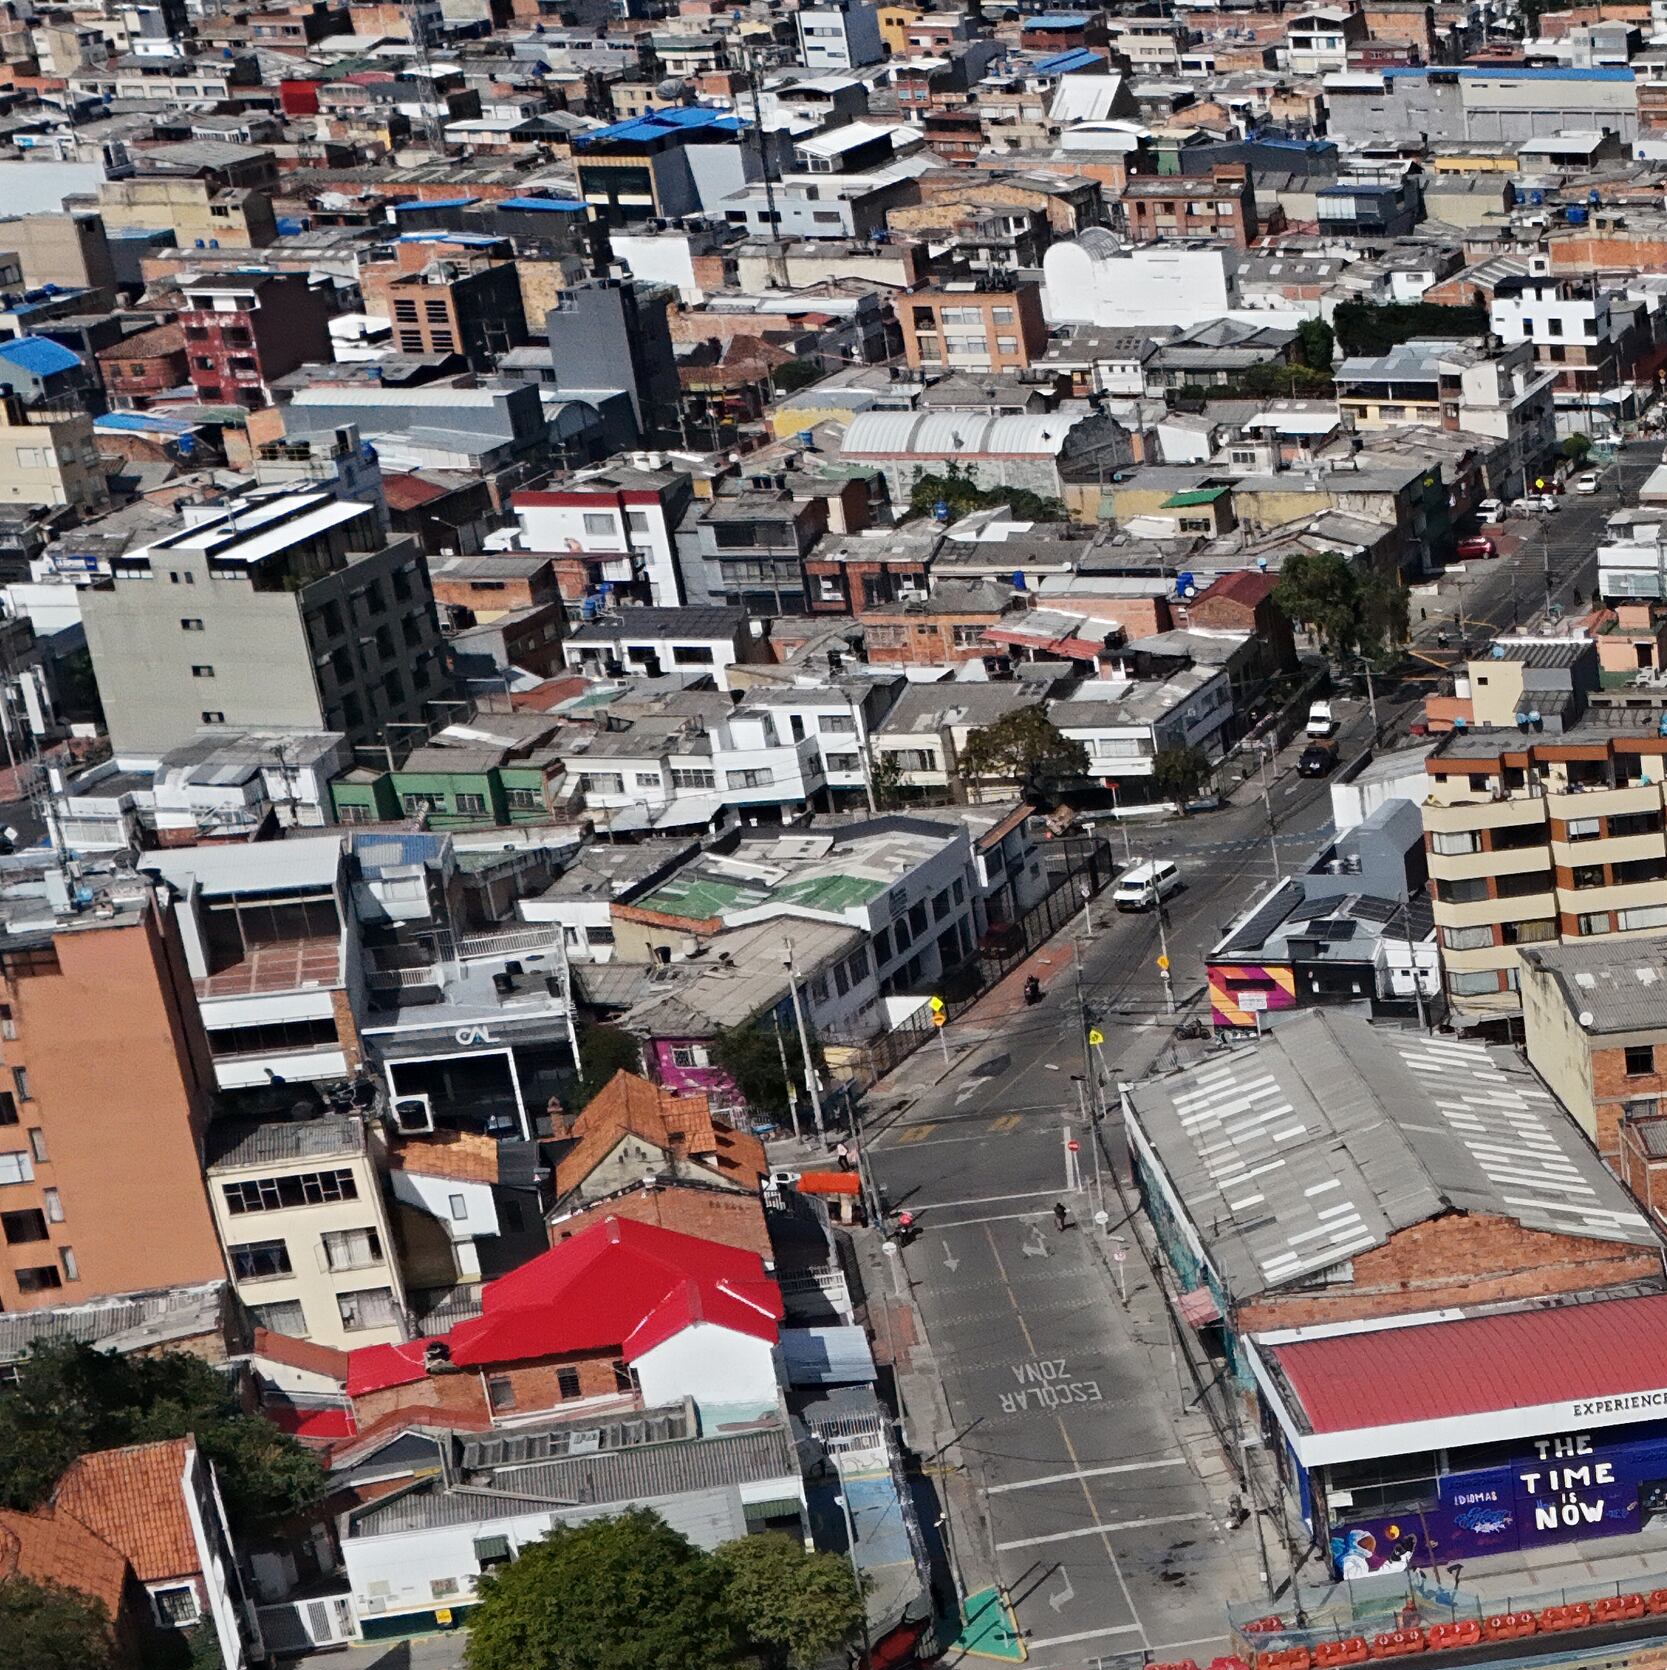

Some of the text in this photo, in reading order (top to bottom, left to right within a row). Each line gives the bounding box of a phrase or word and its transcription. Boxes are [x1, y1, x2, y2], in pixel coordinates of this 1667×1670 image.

[1012, 1360, 1071, 1384] ZONA
[999, 1382, 1103, 1412] ESCOLAR
[1534, 1435, 1593, 1460] THE
[1520, 1463, 1615, 1494] TIME
[1454, 1491, 1498, 1507] IDIOMAS
[1562, 1492, 1577, 1504] IS
[1535, 1500, 1604, 1531] NOW
